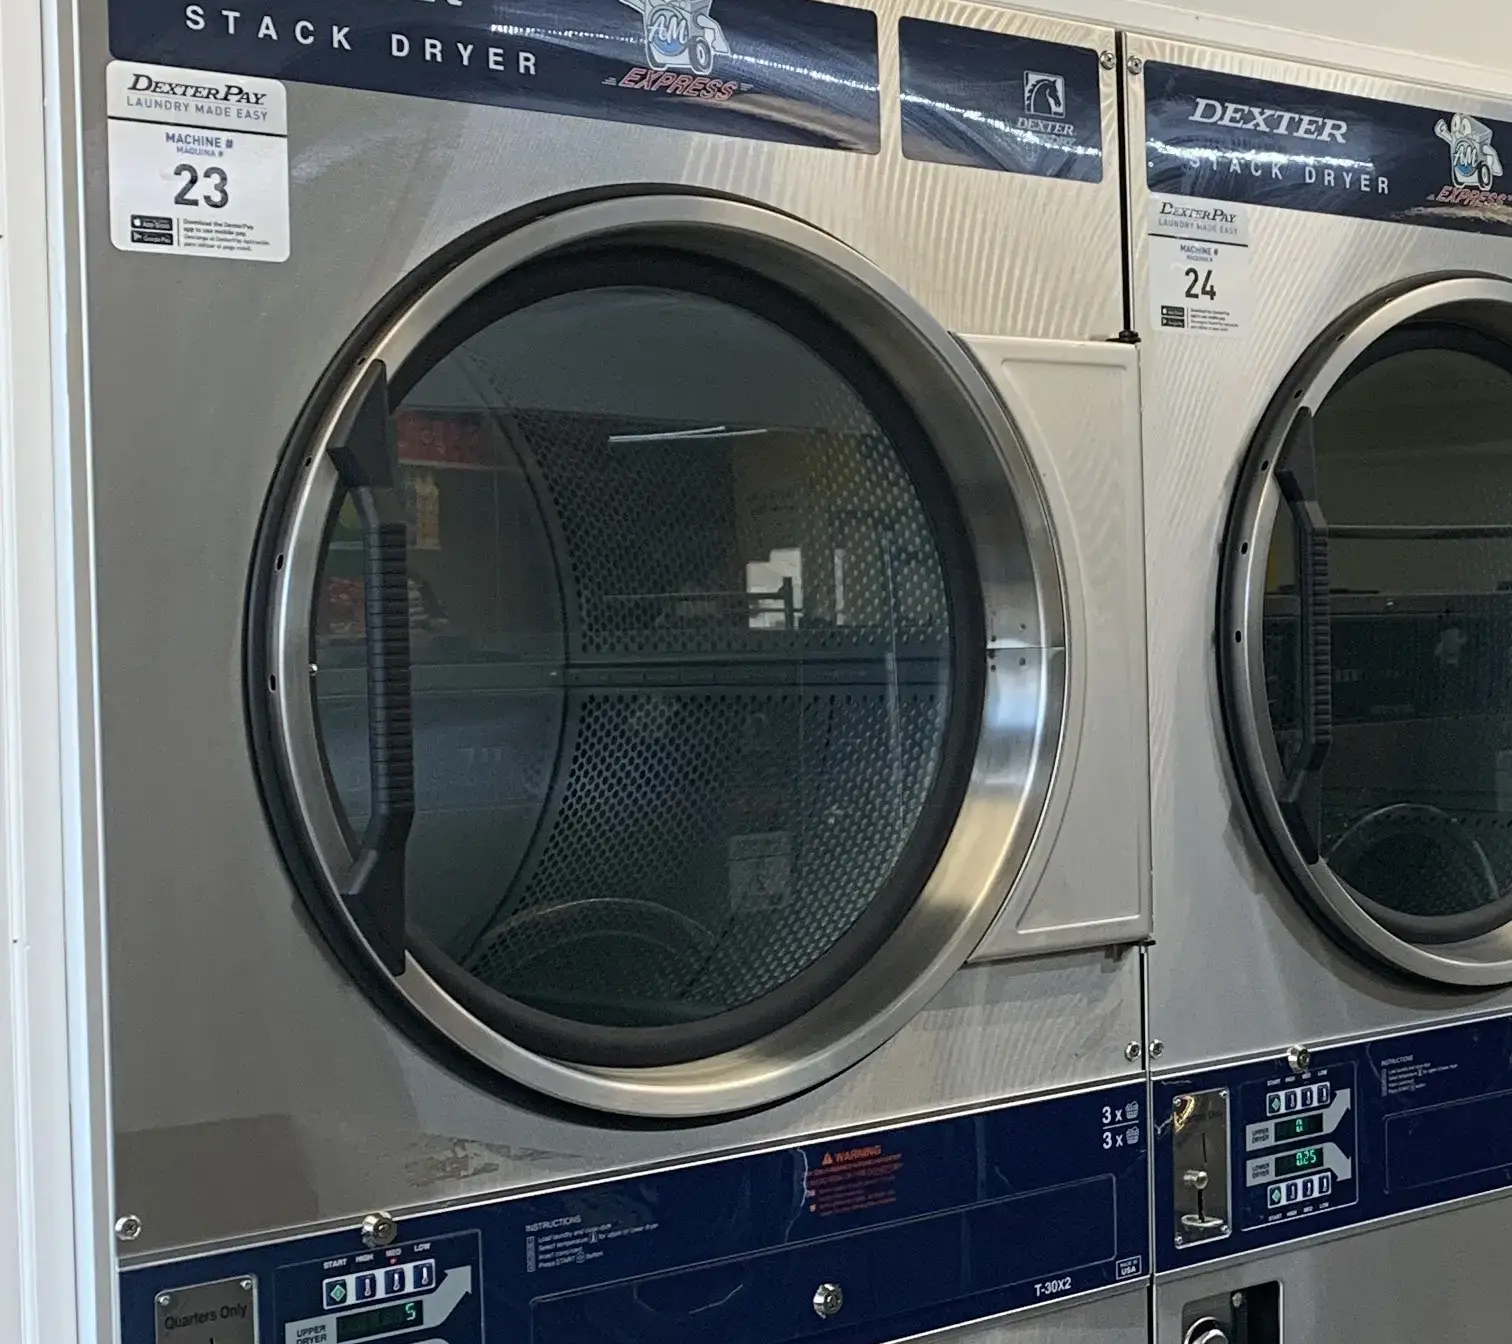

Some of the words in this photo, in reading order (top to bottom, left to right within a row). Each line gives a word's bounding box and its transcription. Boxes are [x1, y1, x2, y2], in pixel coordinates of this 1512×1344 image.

[647, 13, 688, 45] AM
[184, 4, 352, 52] STACK
[391, 32, 537, 75] DRYER
[618, 67, 738, 101] EXPRESS
[126, 95, 190, 112] LAUNDRY
[194, 104, 231, 118] MADE
[236, 109, 268, 122] EASY
[1015, 116, 1075, 136] DEXTER
[1188, 97, 1348, 144] DEXTER
[164, 131, 221, 149] MACHINE
[225, 138, 234, 149] #
[173, 163, 229, 209] 23
[1304, 166, 1389, 195] DRYER
[1435, 185, 1507, 207] EXPRESS
[1158, 218, 1194, 230] LAUNDRY
[1196, 222, 1218, 233] MADE
[1219, 225, 1238, 235] EASY
[1180, 243, 1212, 255] MACHINE
[1184, 267, 1217, 301] 24
[1101, 1106, 1112, 1124] 3
[1115, 1108, 1123, 1122] x
[1102, 1131, 1113, 1150] 3
[1115, 1134, 1124, 1148] x
[1251, 1127, 1269, 1138] UPPER
[1251, 1133, 1270, 1144] DRYER
[1251, 1161, 1270, 1173] LOWER
[1251, 1168, 1270, 1180] DRYER
[525, 1214, 581, 1233] INSTRUCTIONS
[323, 1258, 348, 1270] START
[355, 1253, 374, 1263] HIGH
[385, 1248, 402, 1257] MED
[413, 1242, 431, 1252] LOW
[1121, 1265, 1137, 1276] USA
[1034, 1276, 1072, 1297] T-30X2
[163, 1309, 218, 1331] Quarters
[220, 1303, 249, 1321] Only
[405, 1302, 416, 1321] 5
[296, 1324, 326, 1338] UPPER
